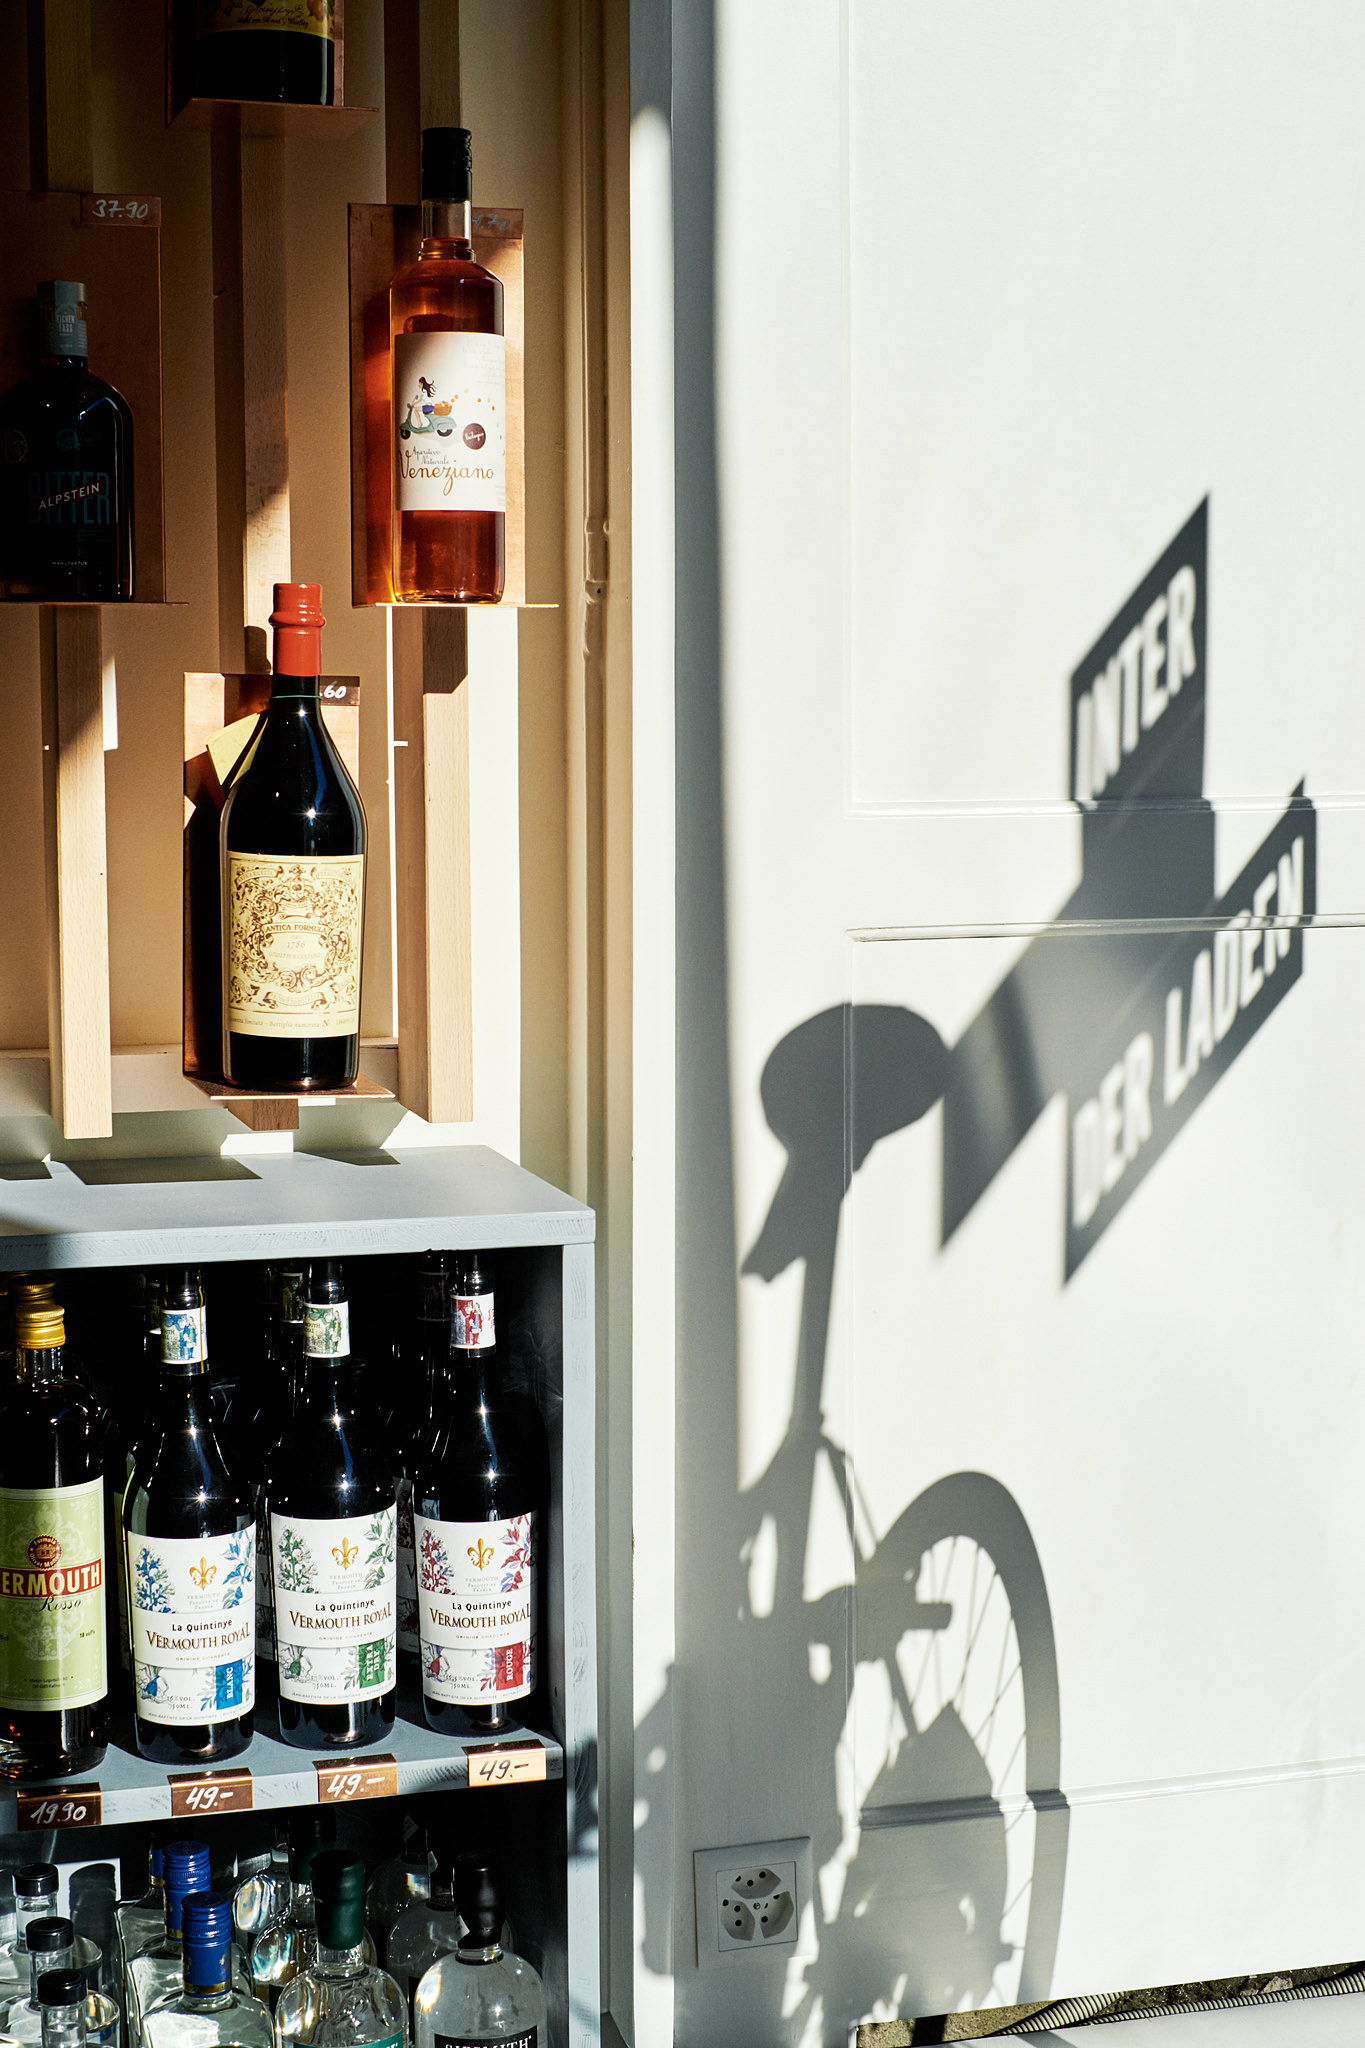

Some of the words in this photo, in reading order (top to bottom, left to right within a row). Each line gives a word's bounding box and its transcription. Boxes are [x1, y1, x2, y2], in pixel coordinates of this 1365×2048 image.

[91, 199, 150, 219] 37.90
[399, 449, 495, 497] Veneziano
[26, 470, 111, 526] BITTER
[38, 481, 101, 512] ALPSTEIN
[265, 924, 292, 933] ANTICA
[294, 924, 327, 934] FORMULA
[1073, 1031, 1154, 1230] DER
[1164, 836, 1304, 1106] LADEN
[2, 1561, 101, 1596] ERMOUTH
[39, 1595, 82, 1612] Rosso
[289, 1610, 360, 1630] VERMOUTH
[364, 1601, 393, 1627] ROYAL
[315, 1603, 326, 1612] La
[329, 1598, 375, 1612] Quintinye
[429, 1607, 497, 1629] VERMOUTH
[500, 1602, 532, 1627] ROYAL
[452, 1602, 462, 1611] La
[466, 1599, 512, 1612] Quintinye
[145, 1629, 218, 1651] VERMOUTH
[221, 1621, 251, 1647] ROYAL
[172, 1623, 183, 1632] La
[186, 1618, 233, 1633] Quintinye
[506, 1648, 514, 1681] ROUGE
[226, 1666, 234, 1700] BLANC
[478, 1757, 530, 1782] 49.-
[326, 1771, 385, 1797] 49.-
[30, 1800, 88, 1823] 19.90
[185, 1786, 234, 1811] 49.-
